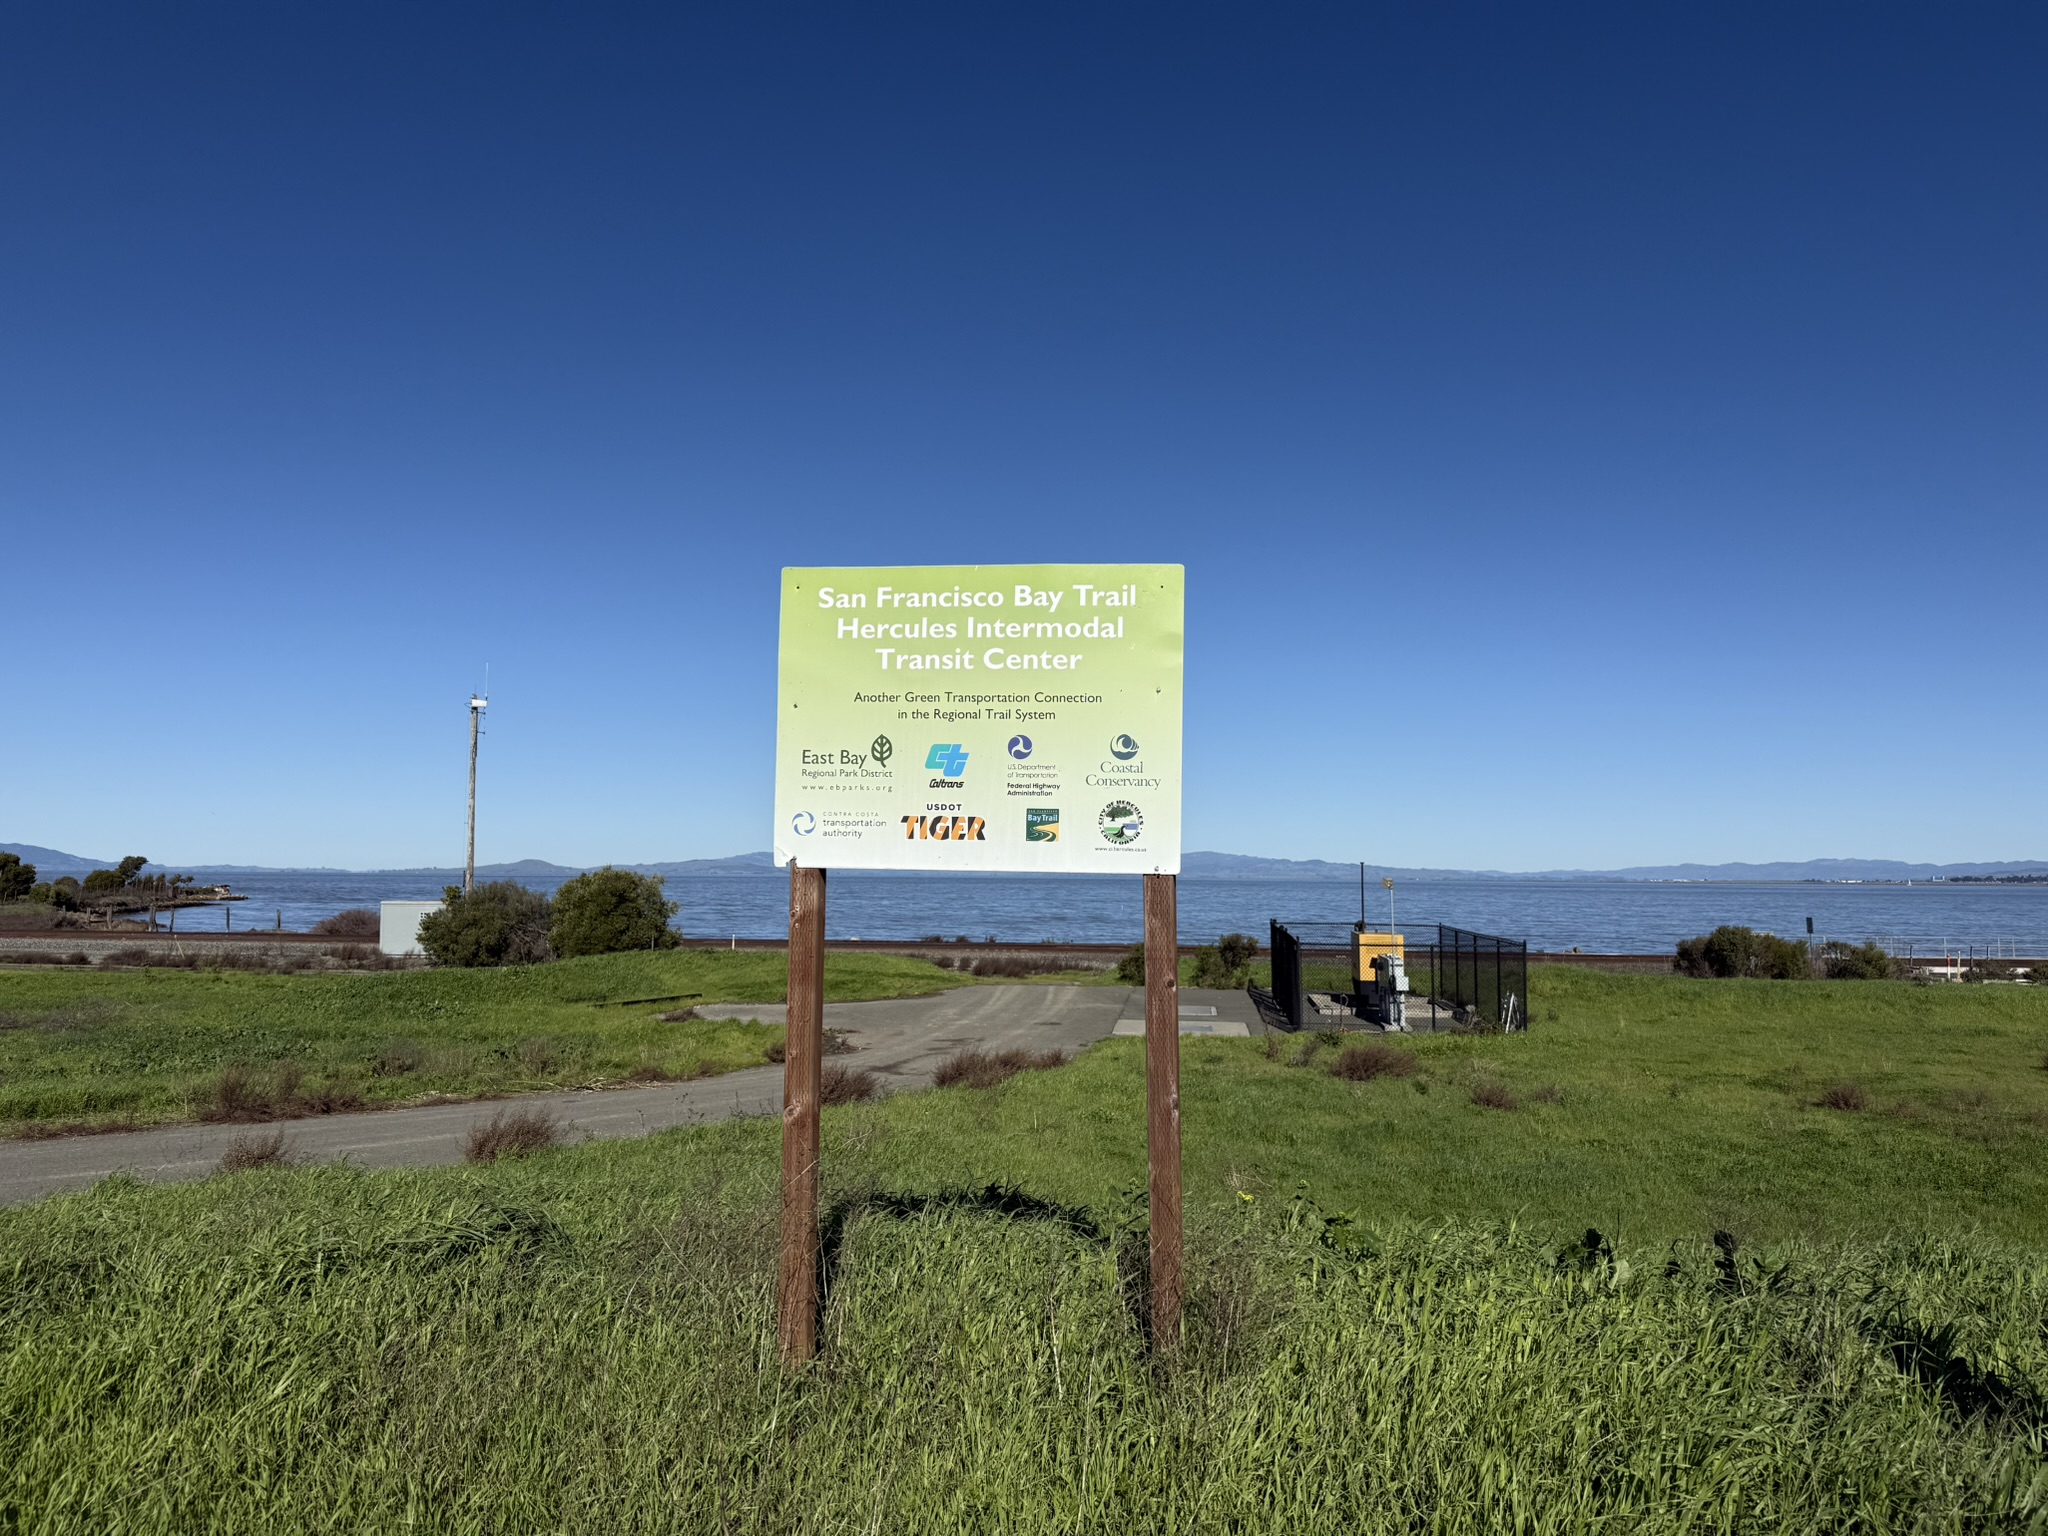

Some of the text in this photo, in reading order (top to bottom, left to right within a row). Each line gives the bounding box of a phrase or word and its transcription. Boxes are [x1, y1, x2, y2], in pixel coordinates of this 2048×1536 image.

[818, 584, 1136, 612] San Francisco Bay Trail
[837, 616, 1124, 639] Hercules Intermodal
[875, 647, 1082, 670] Transit Center
[854, 691, 1103, 705] Another Green Transportation Connection
[897, 709, 1056, 723] in the Regional Trail System
[802, 749, 867, 769] East Bay
[1018, 763, 1056, 771] Department
[1100, 761, 1144, 773] Coastal
[801, 768, 893, 779] Regional Park District
[801, 783, 893, 792] www.ebparks.org
[929, 778, 965, 788] Caltrans
[1032, 782, 1061, 790] Highway
[1085, 774, 1162, 790] Conservancy
[926, 803, 962, 811] USDOT
[822, 819, 887, 829] transportation
[1027, 814, 1041, 823] Bay
[822, 828, 863, 839] authority
[901, 815, 986, 841] TIGER
